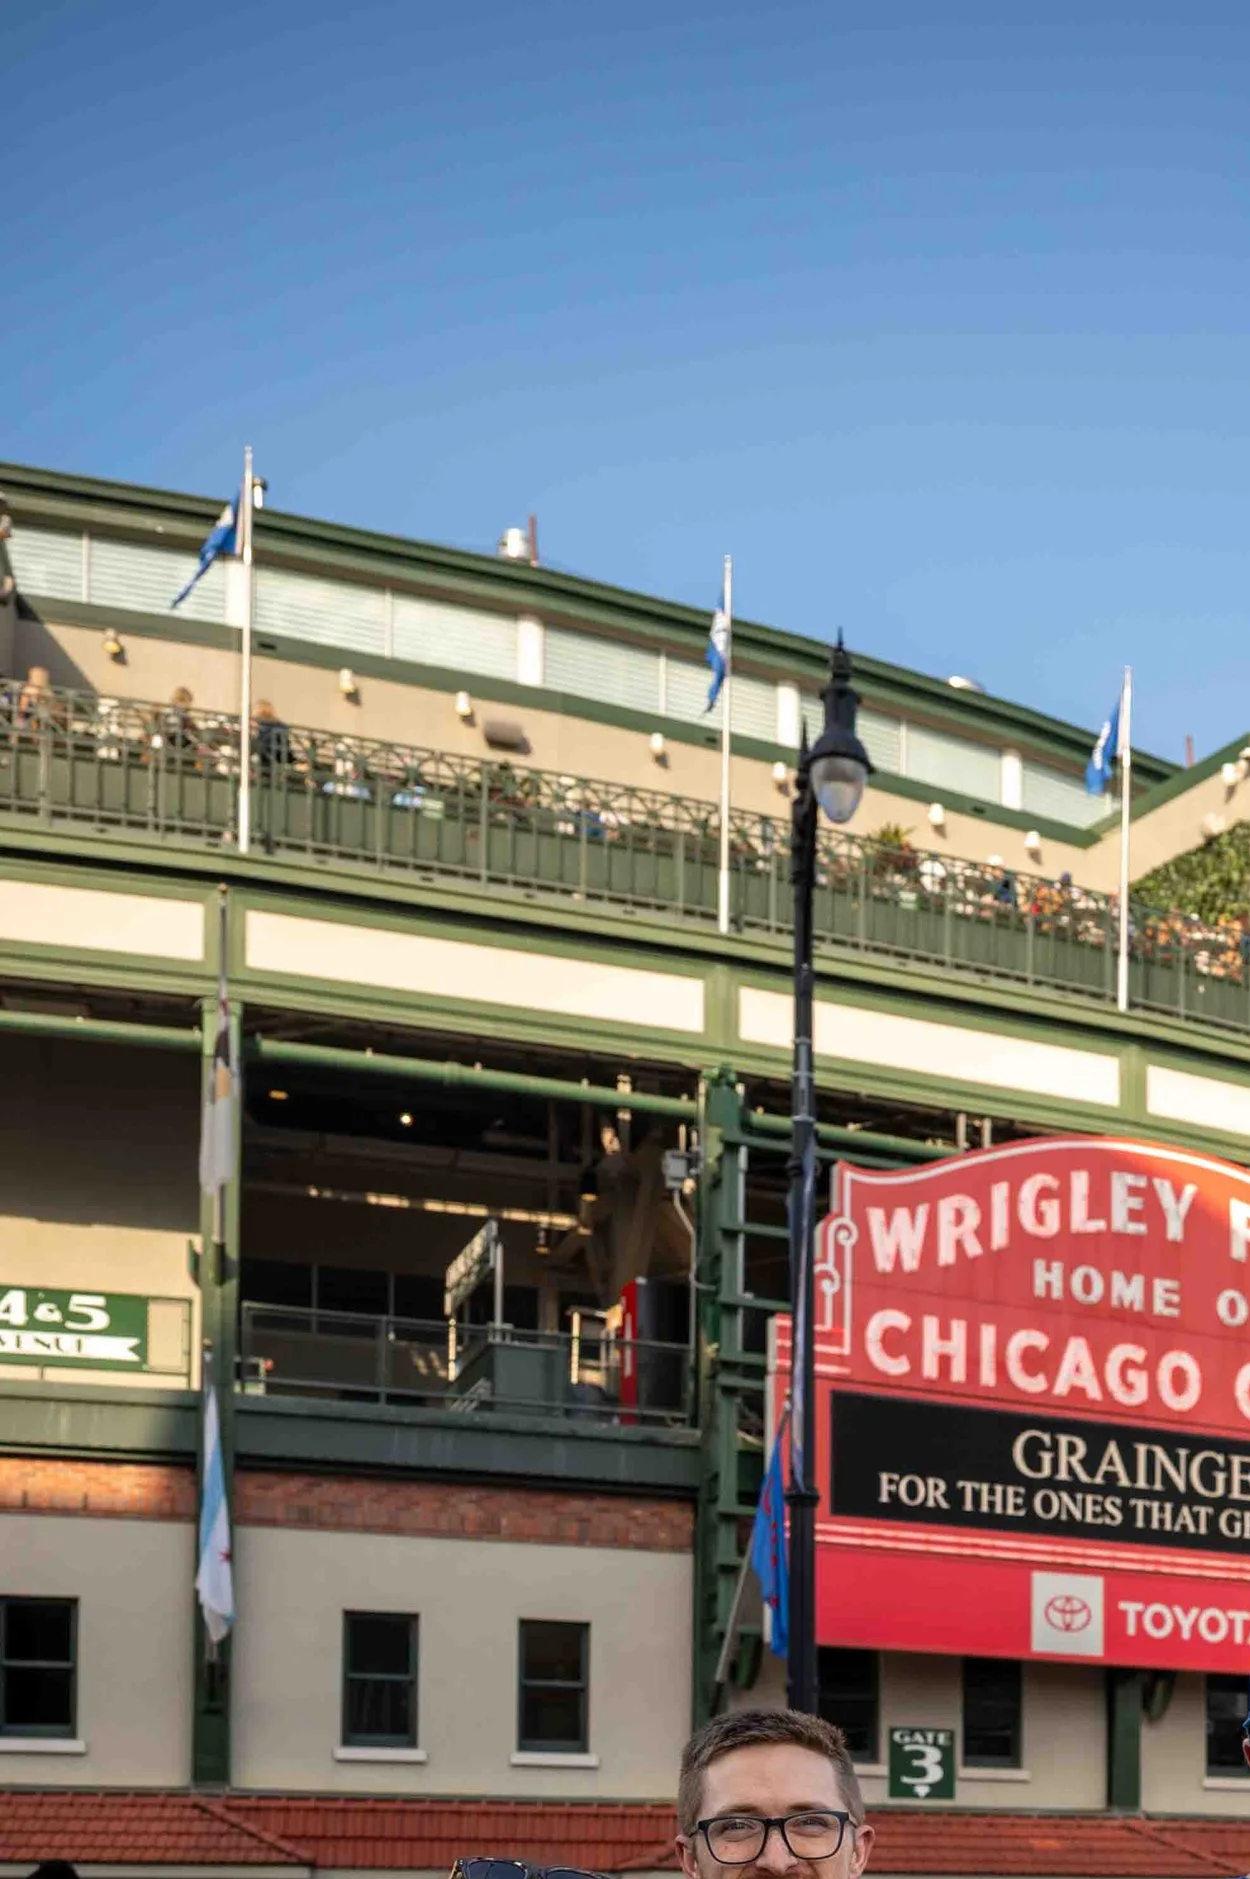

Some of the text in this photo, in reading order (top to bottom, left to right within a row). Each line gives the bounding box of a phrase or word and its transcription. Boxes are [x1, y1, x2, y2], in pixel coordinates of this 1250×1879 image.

[866, 1170, 1198, 1273] WRIGLEY
[1033, 1258, 1181, 1318] HOME
[0, 1333, 84, 1354] VENUE
[864, 1308, 1202, 1412] CHICAGO
[878, 1471, 950, 1509] FOR
[956, 1479, 1027, 1517] THE
[1033, 1488, 1123, 1527] ONES
[1129, 1498, 1215, 1535] THAT
[892, 1729, 951, 1746] GATE
[900, 1743, 944, 1785] 3
